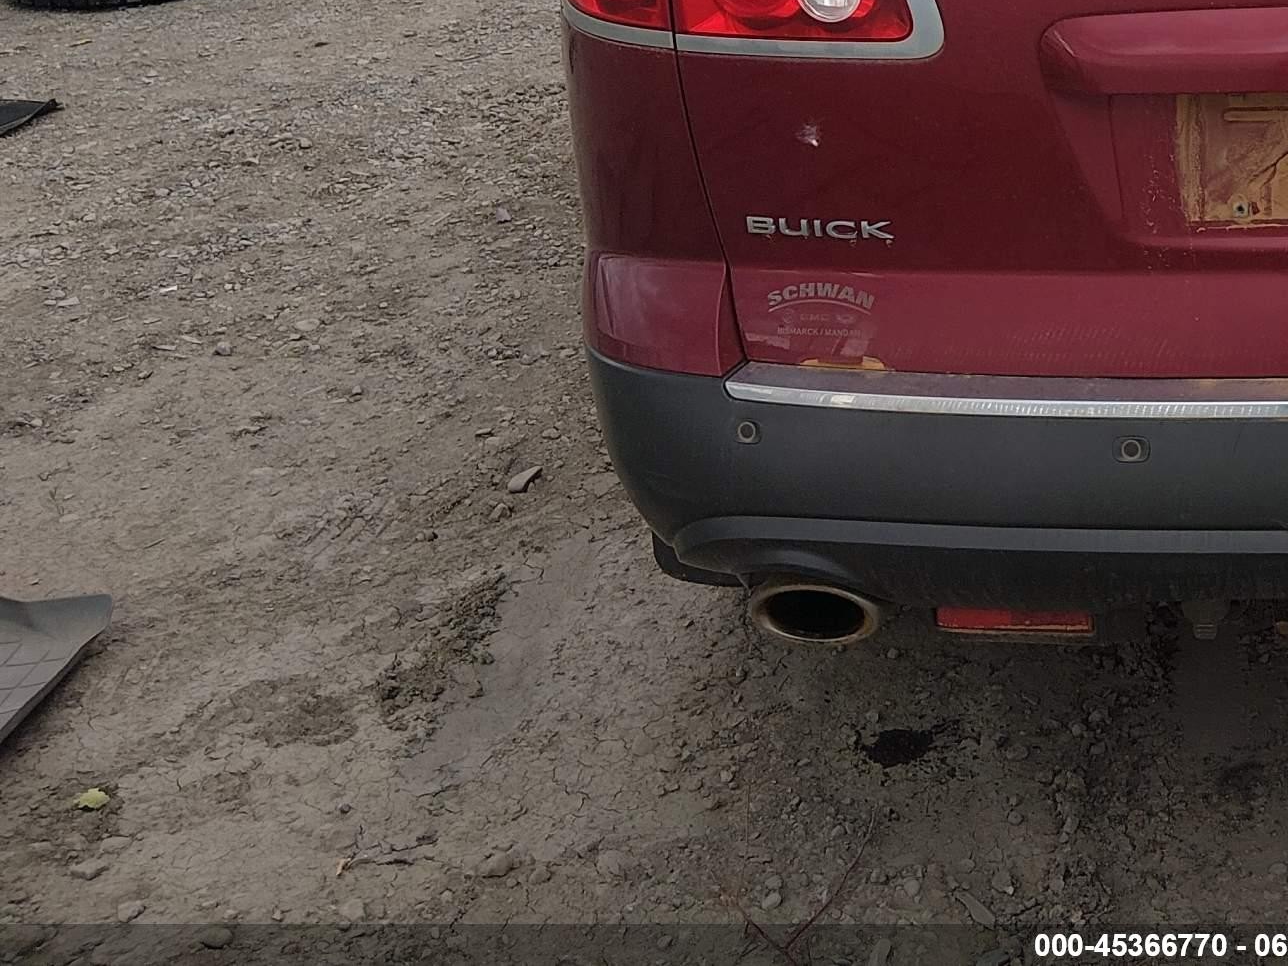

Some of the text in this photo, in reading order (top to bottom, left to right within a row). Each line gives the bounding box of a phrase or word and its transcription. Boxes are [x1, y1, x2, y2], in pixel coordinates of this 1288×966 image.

[746, 215, 895, 240] BUICK
[767, 281, 875, 310] SCHWAN
[777, 326, 818, 336] BISMARCK
